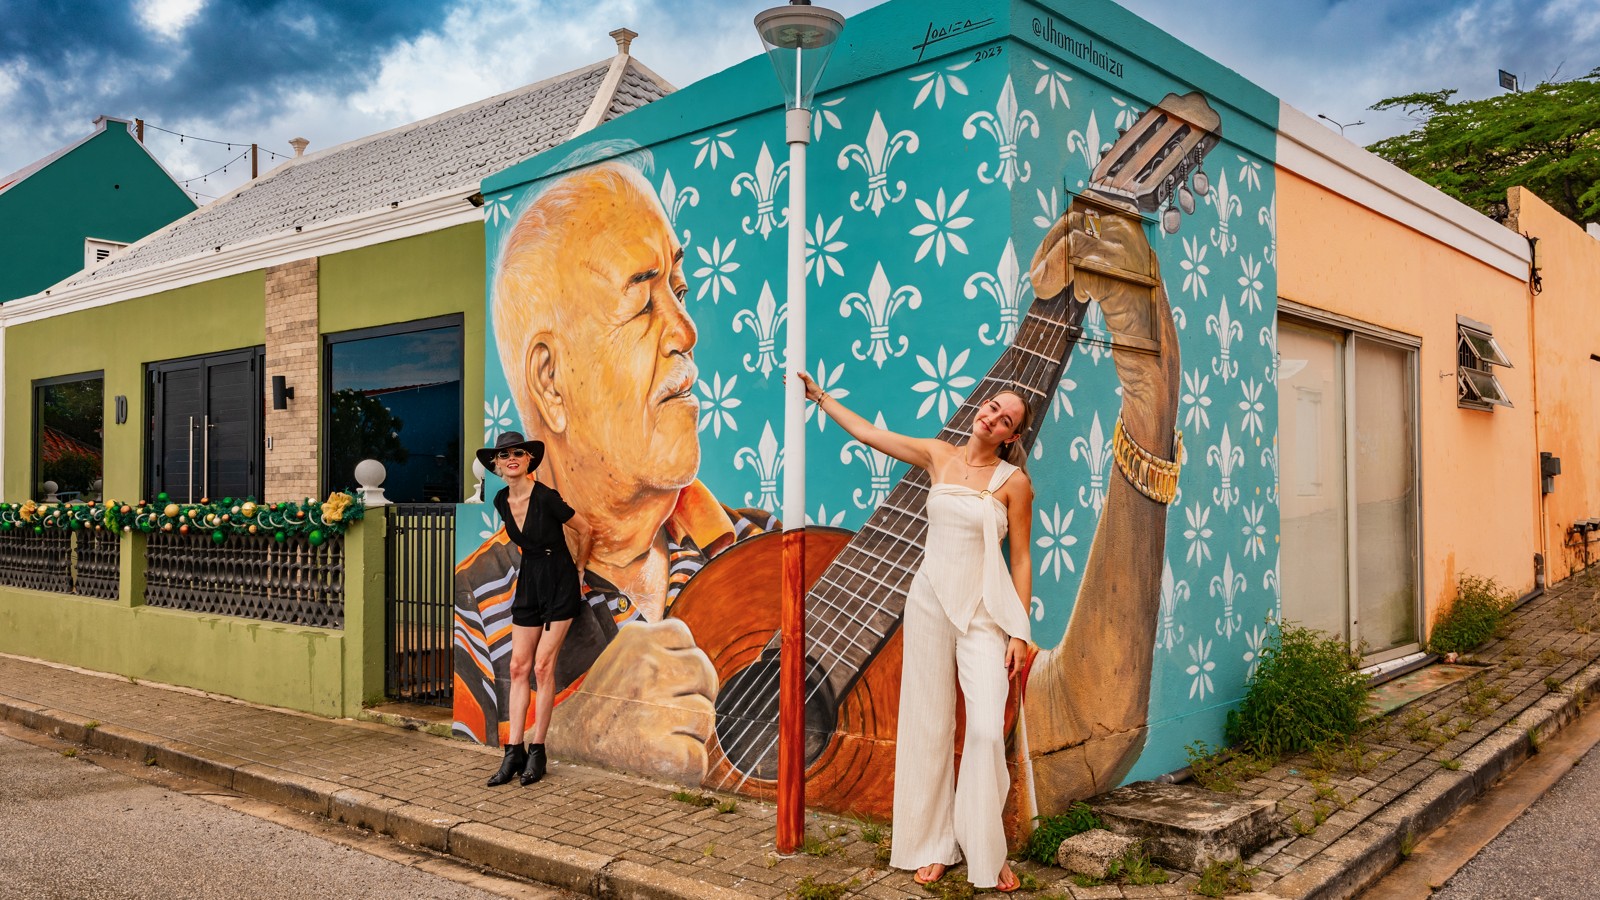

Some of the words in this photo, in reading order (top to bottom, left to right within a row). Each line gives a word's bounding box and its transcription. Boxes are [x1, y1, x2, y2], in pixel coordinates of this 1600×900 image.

[974, 45, 1003, 63] 2023
[1032, 17, 1124, 79] @Jhomarloaiza
[114, 394, 128, 425] 10
